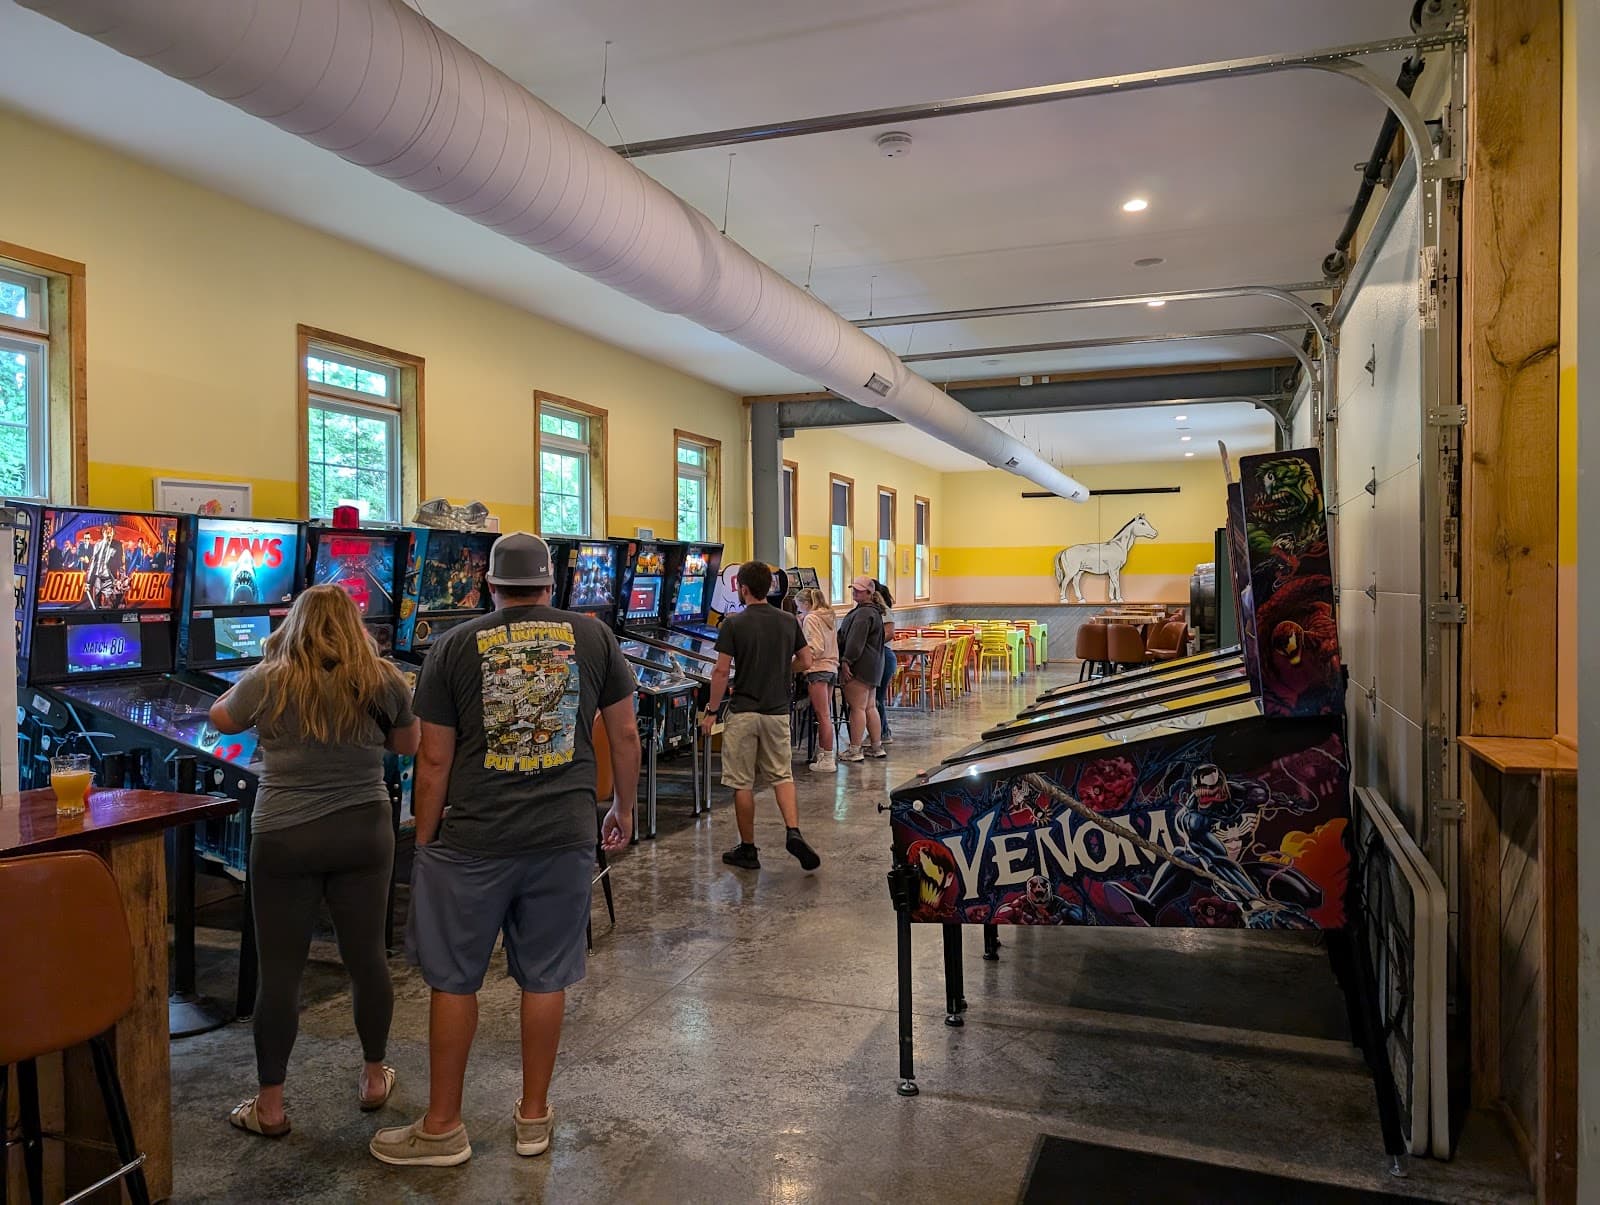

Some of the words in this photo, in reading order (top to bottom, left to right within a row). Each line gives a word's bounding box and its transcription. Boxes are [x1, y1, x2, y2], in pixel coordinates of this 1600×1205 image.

[204, 536, 283, 569] JAWS
[38, 571, 86, 602] JOHN
[127, 572, 170, 602] WICK
[83, 641, 108, 655] MATCH
[109, 637, 126, 656] 80
[484, 753, 517, 772] PUT
[519, 755, 540, 771] IN
[543, 748, 575, 769] BAY
[942, 809, 1176, 900] VENOM
